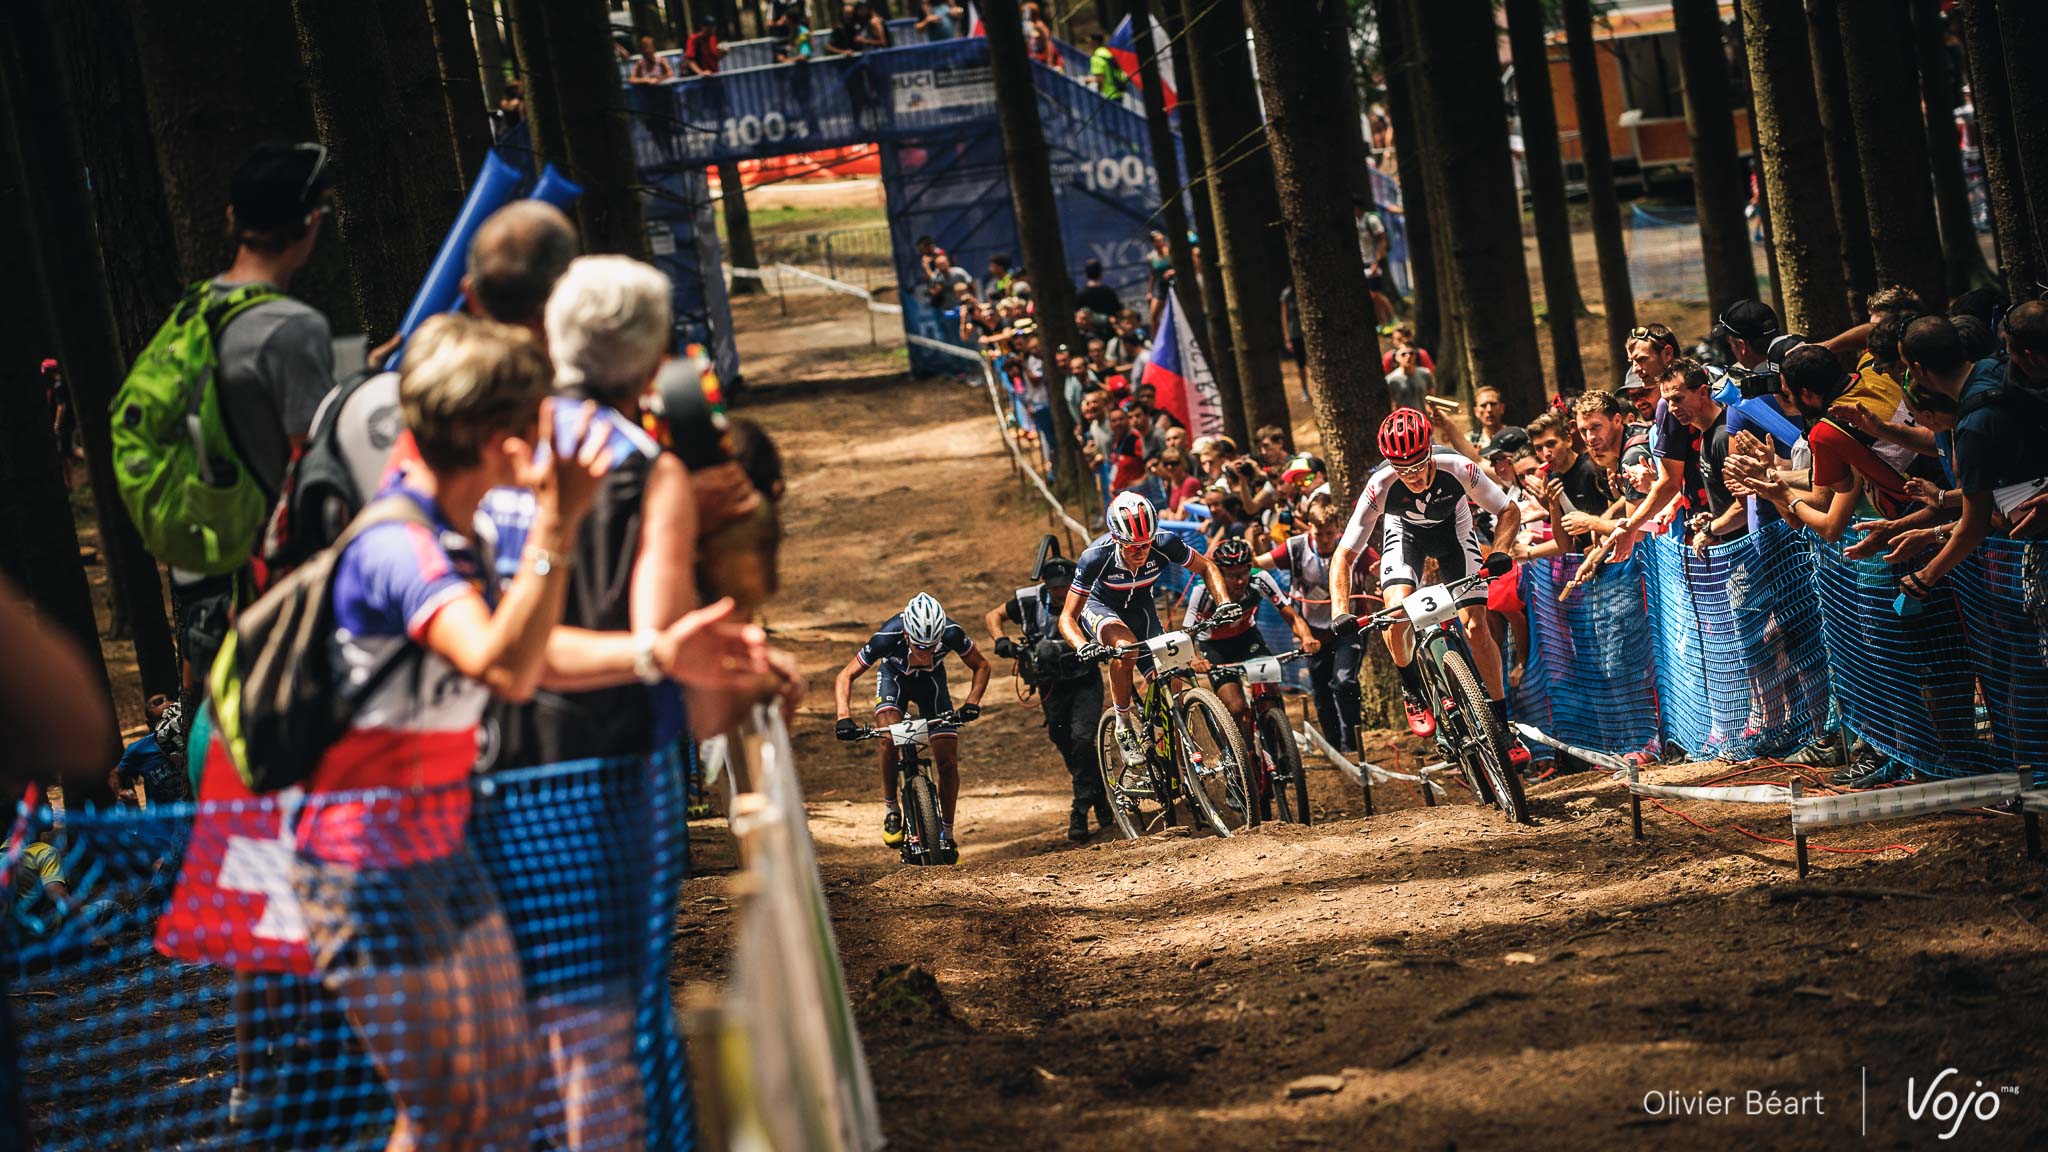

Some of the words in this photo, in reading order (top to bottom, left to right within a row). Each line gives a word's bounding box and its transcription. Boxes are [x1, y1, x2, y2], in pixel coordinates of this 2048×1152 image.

[1421, 596, 1437, 612] 3
[1165, 640, 1179, 657] 5
[1256, 663, 1266, 673] 7
[903, 721, 916, 733] 2
